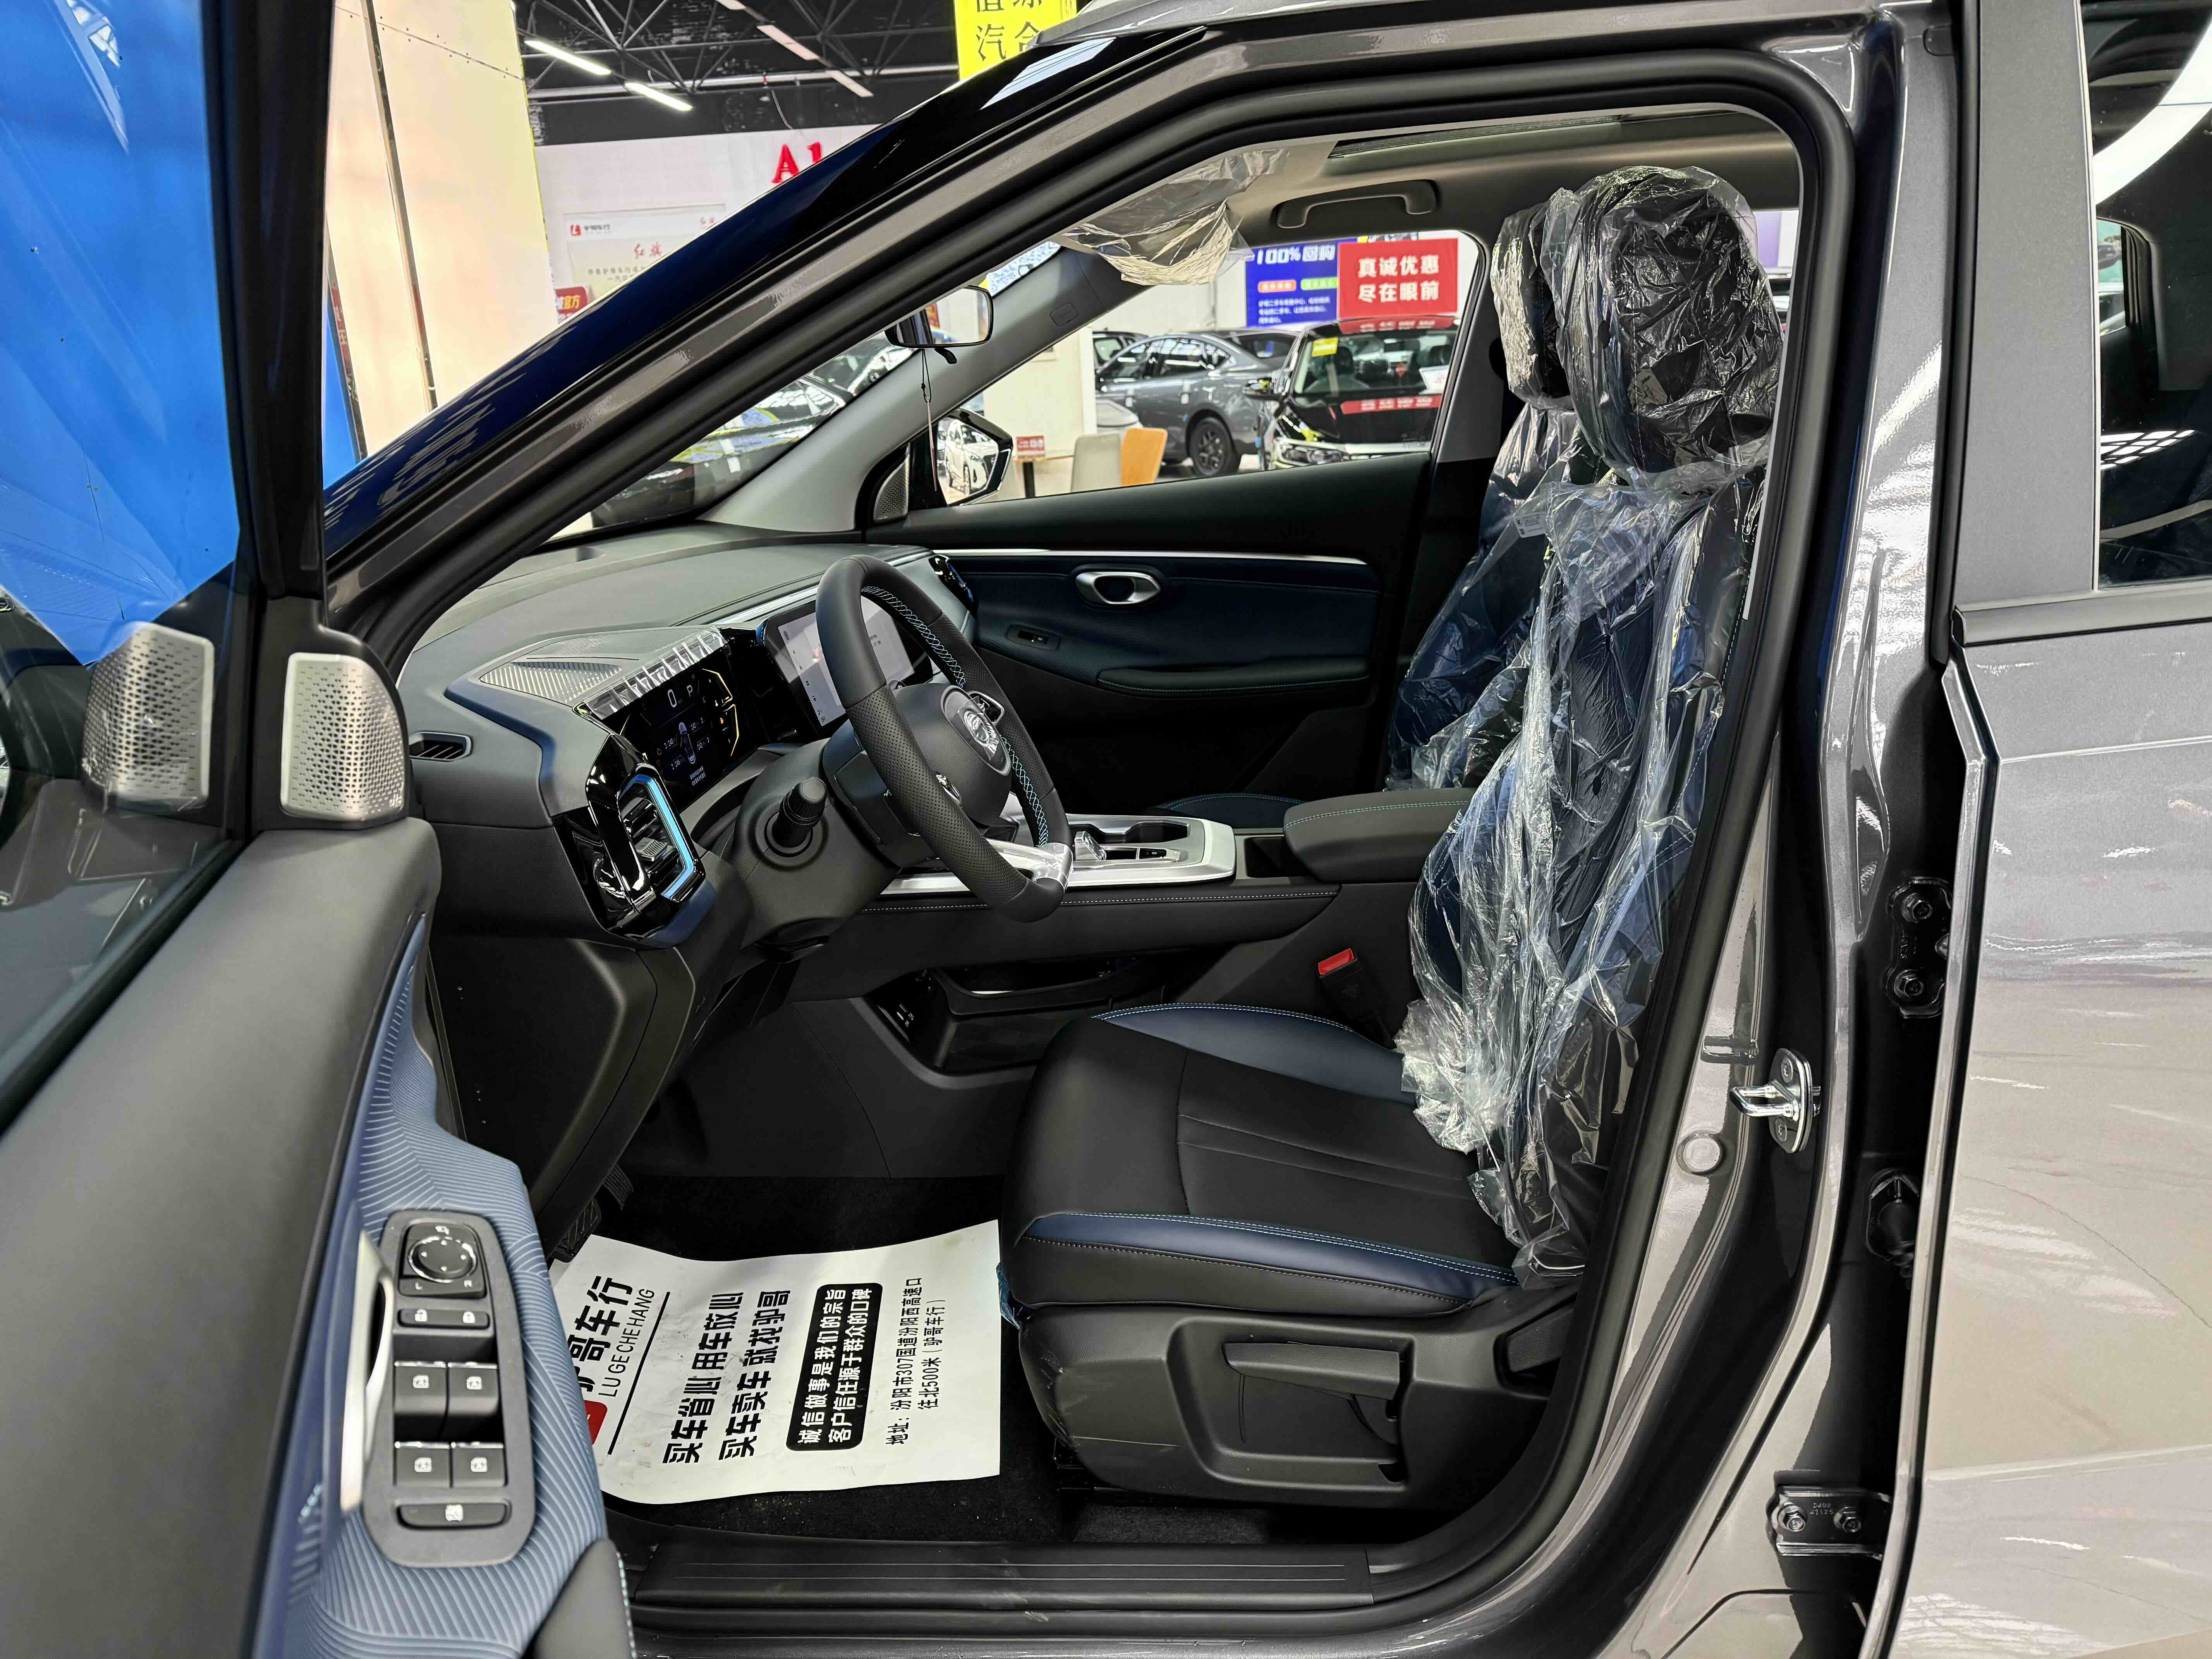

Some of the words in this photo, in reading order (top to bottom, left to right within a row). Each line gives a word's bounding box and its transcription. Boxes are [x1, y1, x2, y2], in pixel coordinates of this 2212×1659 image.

[1358, 254, 1439, 278] 真诚优惠
[1358, 280, 1439, 303] 尽在眼前
[464, 1279, 472, 1288] R
[608, 1354, 630, 1374] GE
[691, 1292, 744, 1370] 用车放心
[742, 1290, 791, 1367] 就找驴哥
[797, 1289, 846, 1444] 诚信做事是我们的宗旨
[828, 1288, 872, 1443] 客户信任源于群众的口碑
[598, 1377, 622, 1397] LU
[662, 1377, 722, 1464] 买车省心
[718, 1370, 771, 1461] 买车卖车
